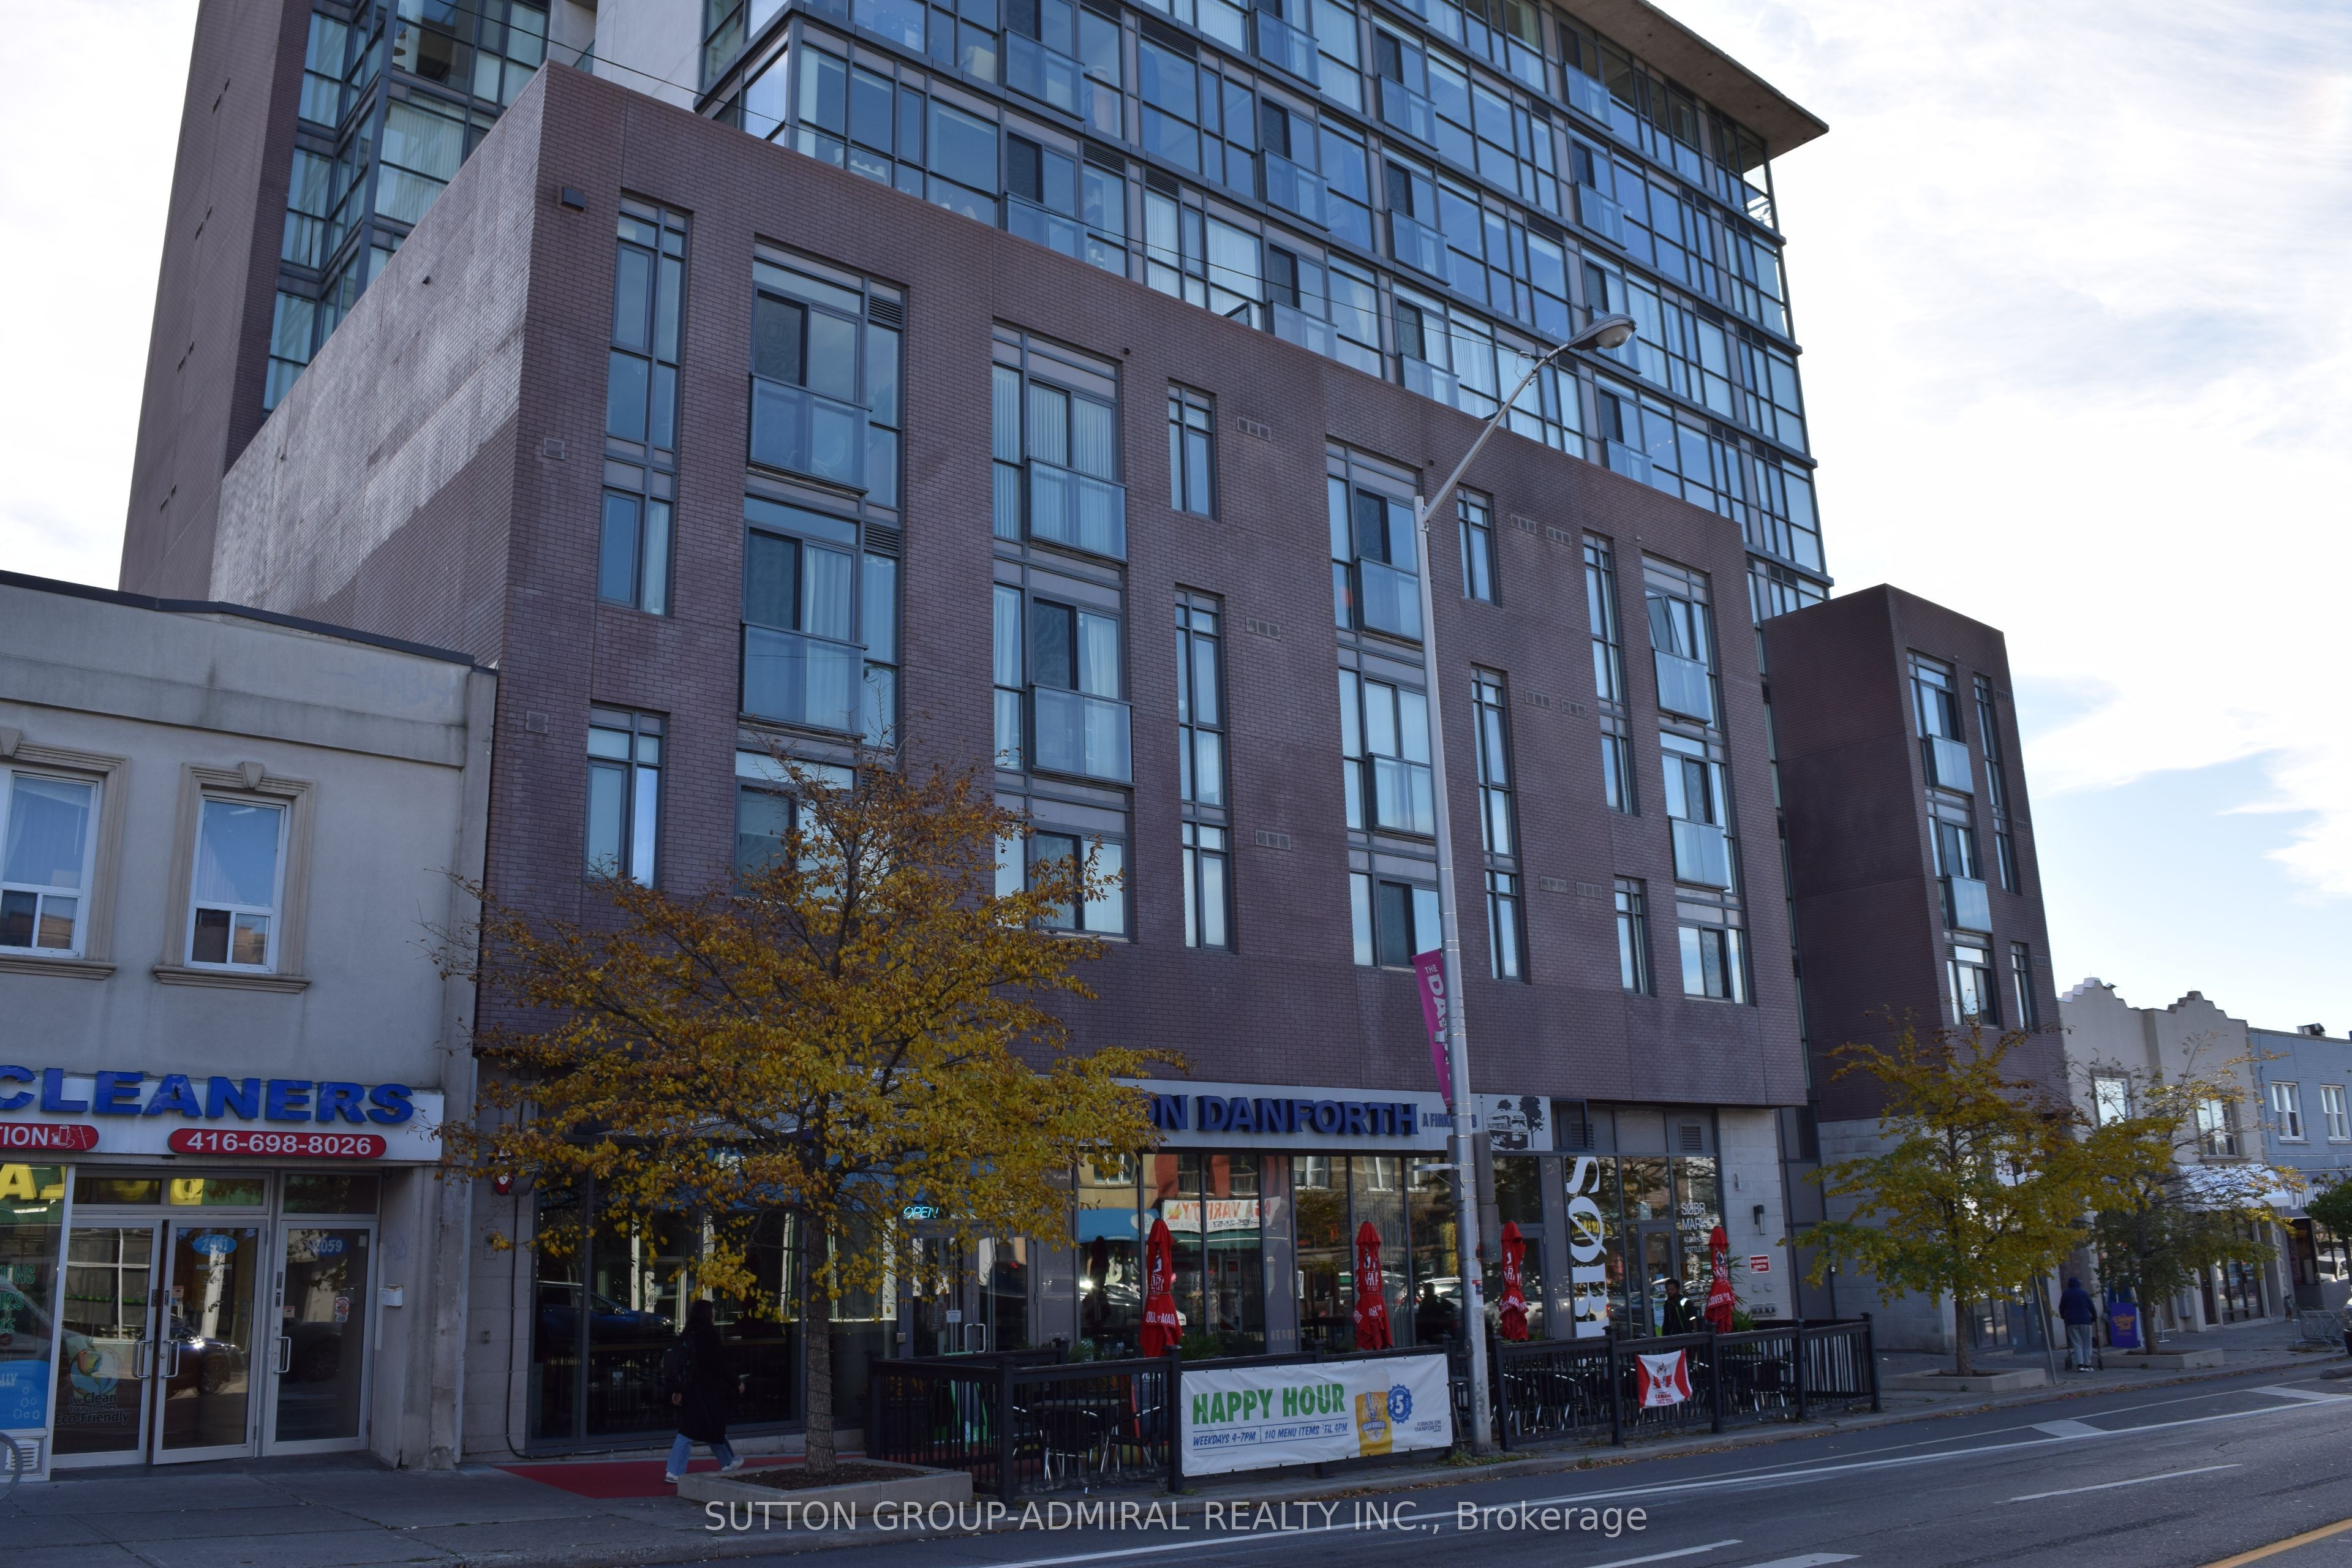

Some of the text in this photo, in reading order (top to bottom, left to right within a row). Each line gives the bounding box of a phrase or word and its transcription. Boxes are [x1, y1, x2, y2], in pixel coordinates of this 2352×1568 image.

[1424, 964, 1438, 974] THE
[0, 1065, 414, 1124] CLEANERS
[1196, 1095, 1419, 1135] DANFORTH
[1430, 1114, 1452, 1127] FIRK
[187, 1132, 371, 1155] 416-698-8026
[903, 1207, 939, 1218] OPEN
[0, 1373, 18, 1387] LLY
[83, 1392, 118, 1403] Clean
[1193, 1383, 1346, 1425] HAPPY HOUR
[56, 1410, 130, 1425] Eco-Friendly
[1265, 1428, 1276, 1440] $10
[1277, 1427, 1297, 1439] MENU
[1298, 1425, 1320, 1436] ITEMS
[1334, 1422, 1348, 1432] 4PM
[1193, 1431, 1256, 1447] WEEKDAYS 4-7PM
